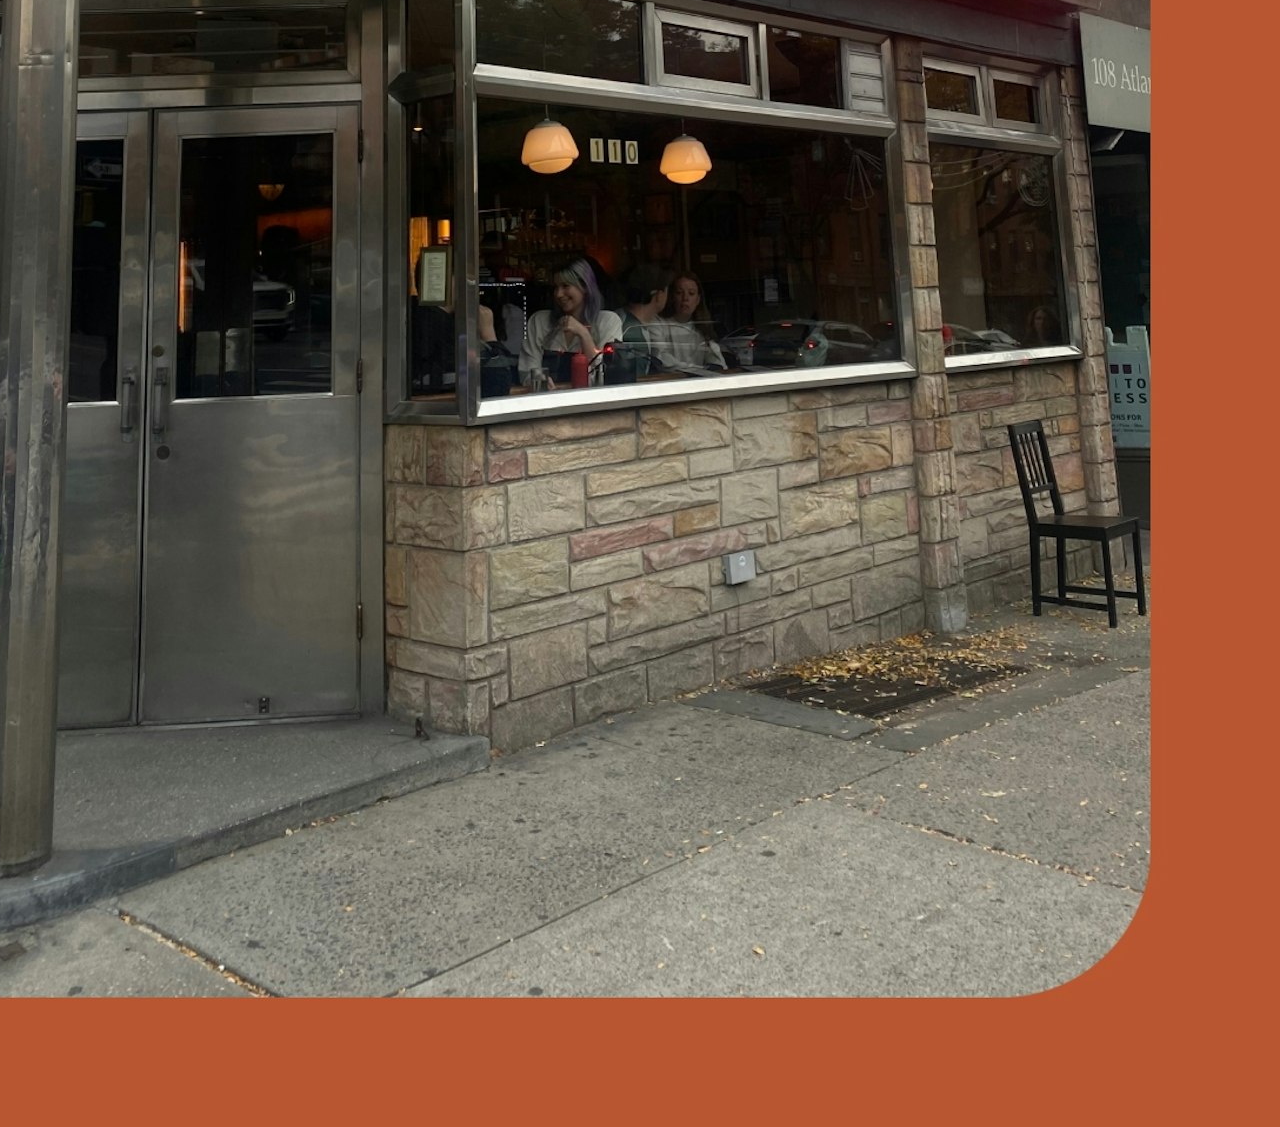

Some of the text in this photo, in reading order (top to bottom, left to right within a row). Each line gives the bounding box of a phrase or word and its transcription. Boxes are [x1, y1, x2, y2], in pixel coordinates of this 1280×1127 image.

[1091, 57, 1116, 88] 108
[591, 139, 638, 163] 110
[1124, 378, 1147, 389] TO
[1114, 393, 1148, 404] ESS
